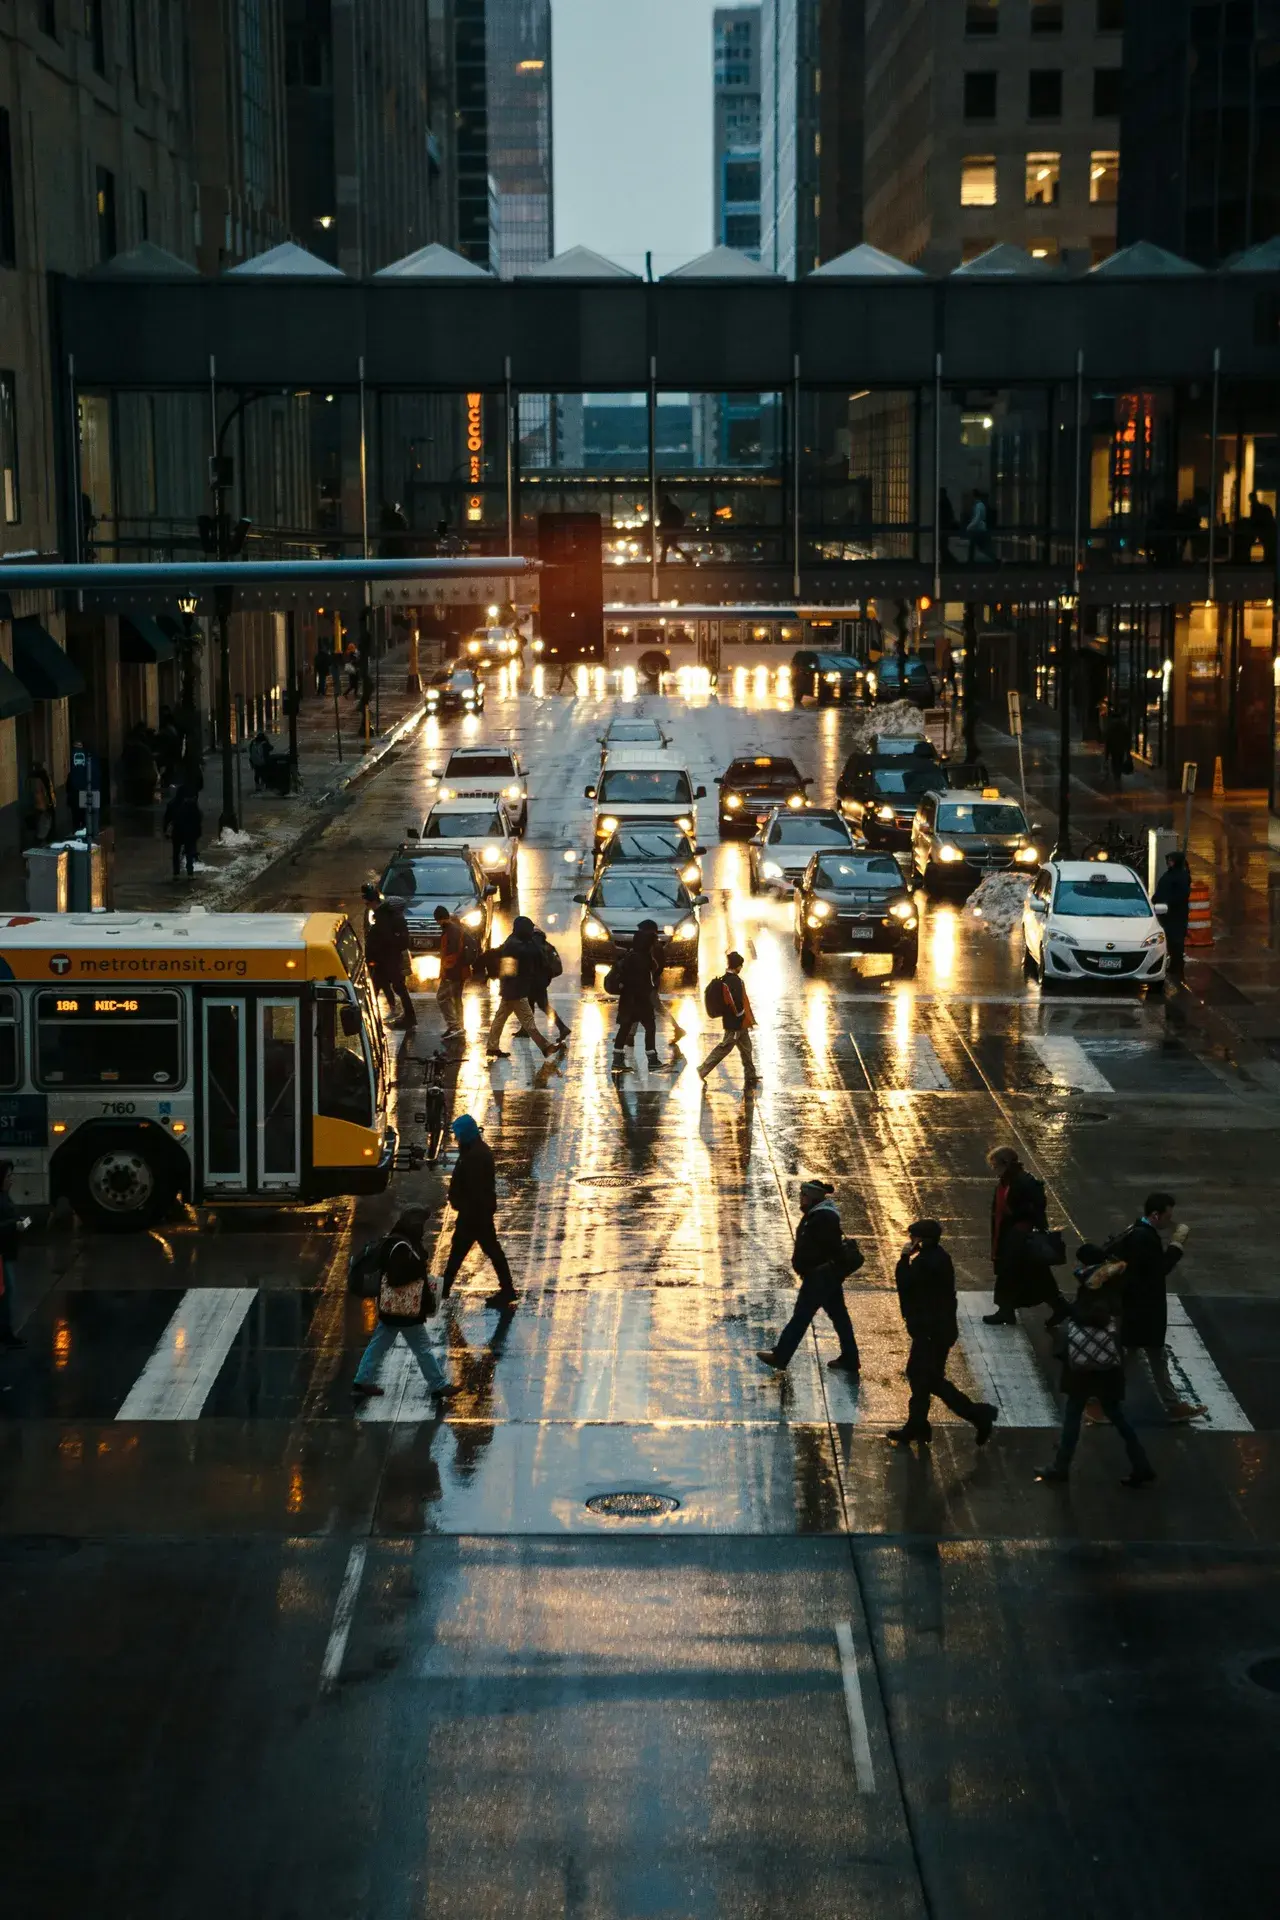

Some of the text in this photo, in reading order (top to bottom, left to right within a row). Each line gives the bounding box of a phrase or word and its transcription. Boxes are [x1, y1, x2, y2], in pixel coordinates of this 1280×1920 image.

[467, 392, 481, 451] WCCO
[80, 956, 248, 976] metrotransit.org
[56, 1000, 139, 1012] 18A NIC-46
[101, 1102, 136, 1115] 7160
